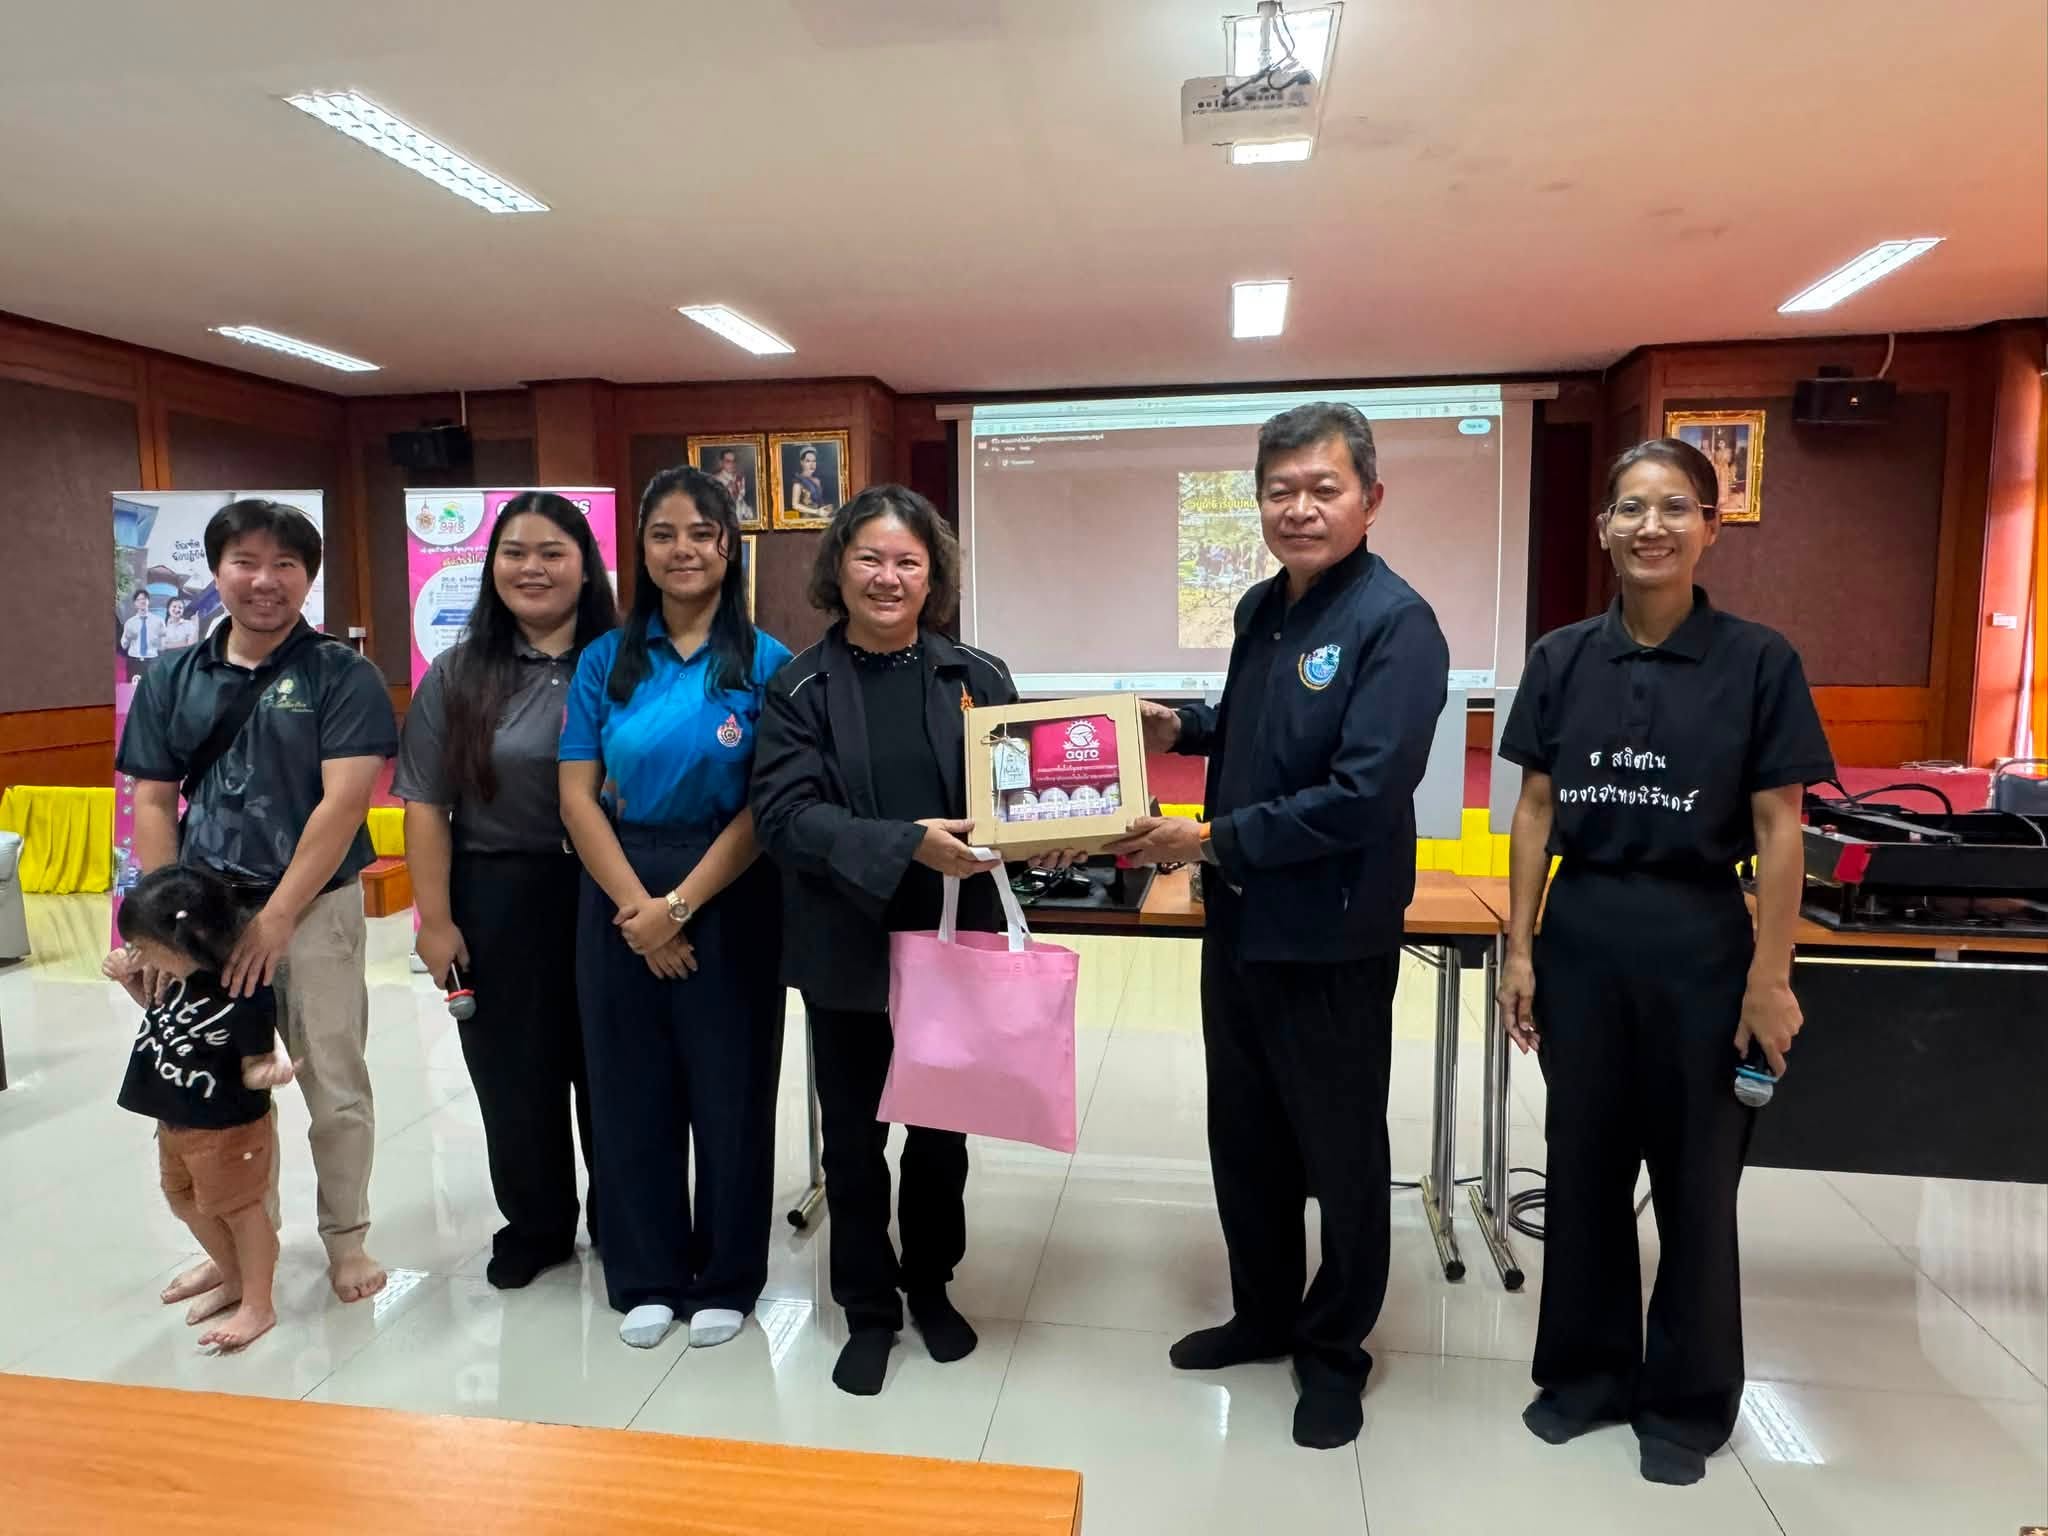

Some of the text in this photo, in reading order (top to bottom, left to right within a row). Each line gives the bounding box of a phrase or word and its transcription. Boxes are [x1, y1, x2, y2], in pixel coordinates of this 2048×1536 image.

[1066, 749, 1099, 761] agro
[1590, 747, 1666, 770] ธ สถิตใน
[1560, 784, 1699, 812] ดวงใจไทยนิรันดร์
